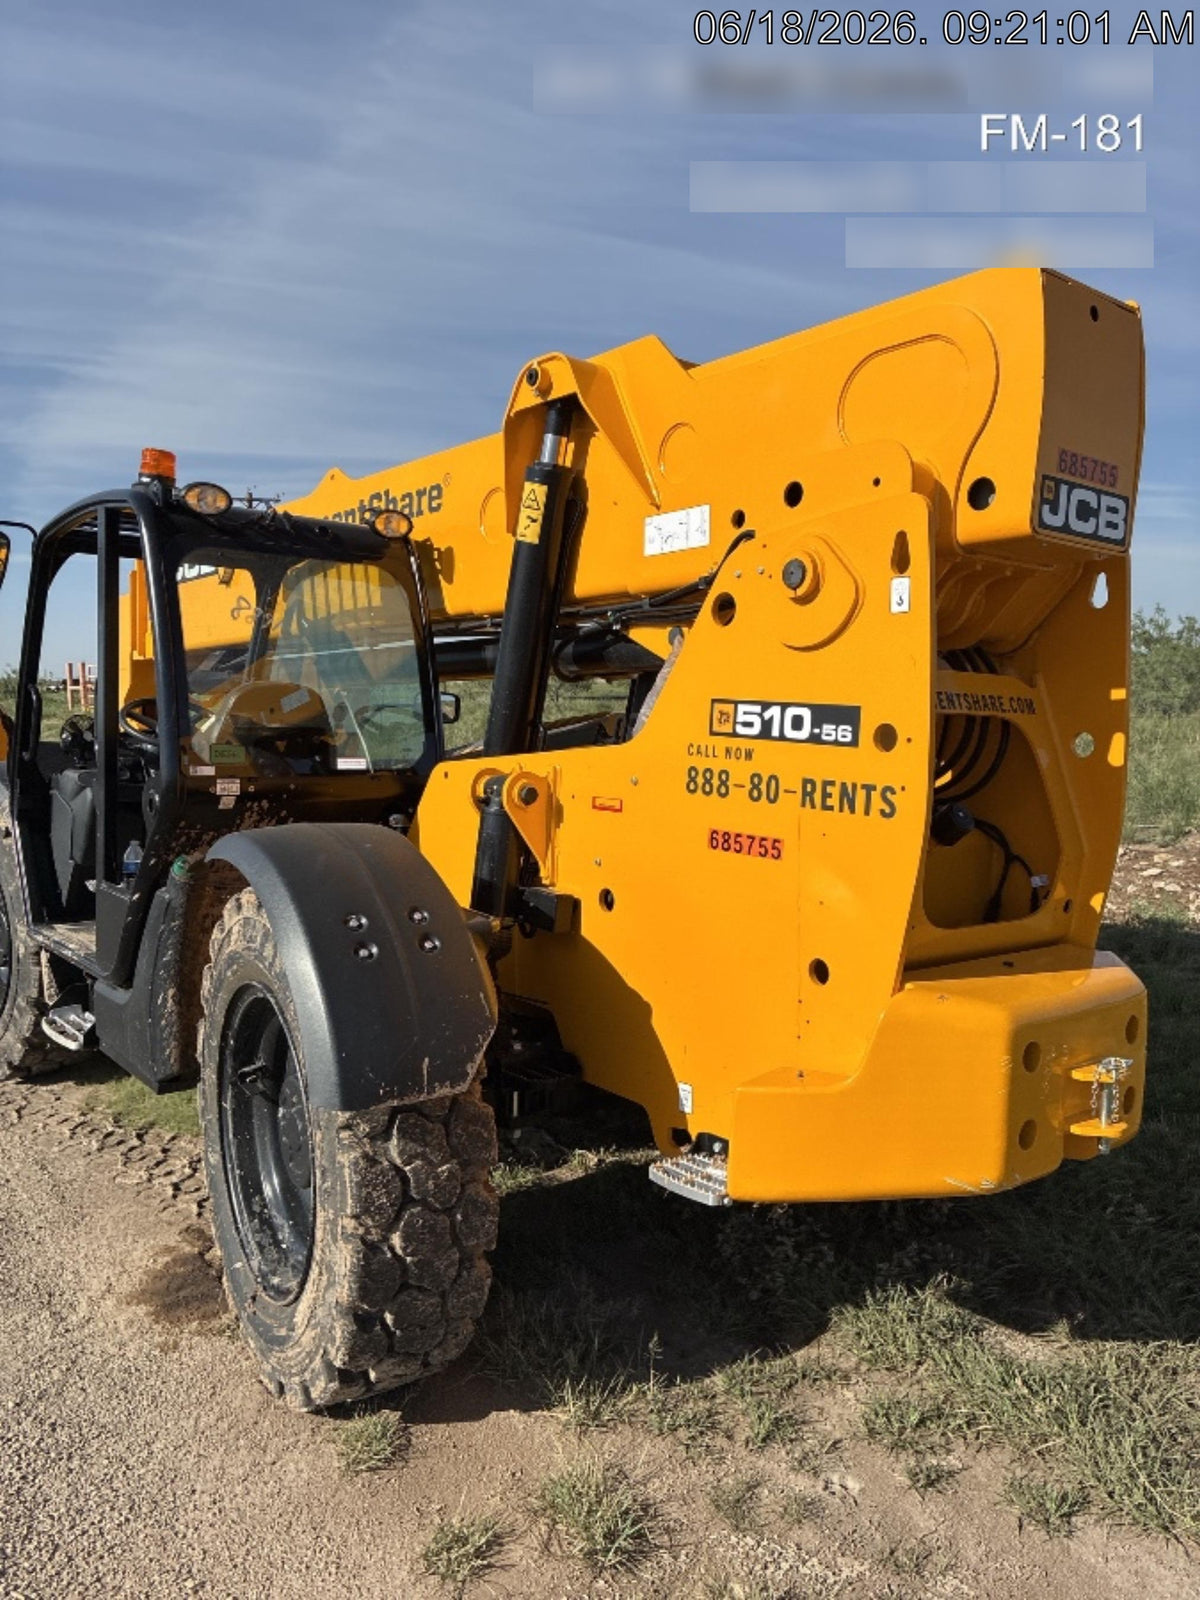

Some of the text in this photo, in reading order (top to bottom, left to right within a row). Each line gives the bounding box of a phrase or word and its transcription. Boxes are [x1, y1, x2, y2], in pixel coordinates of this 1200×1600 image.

[1058, 447, 1118, 488] 685755
[1041, 483, 1127, 540] JCB
[735, 703, 853, 742] 510-56
[687, 742, 755, 761] CALL NOW
[685, 765, 897, 819] 888-80-RENTS
[709, 829, 783, 861] 685755
